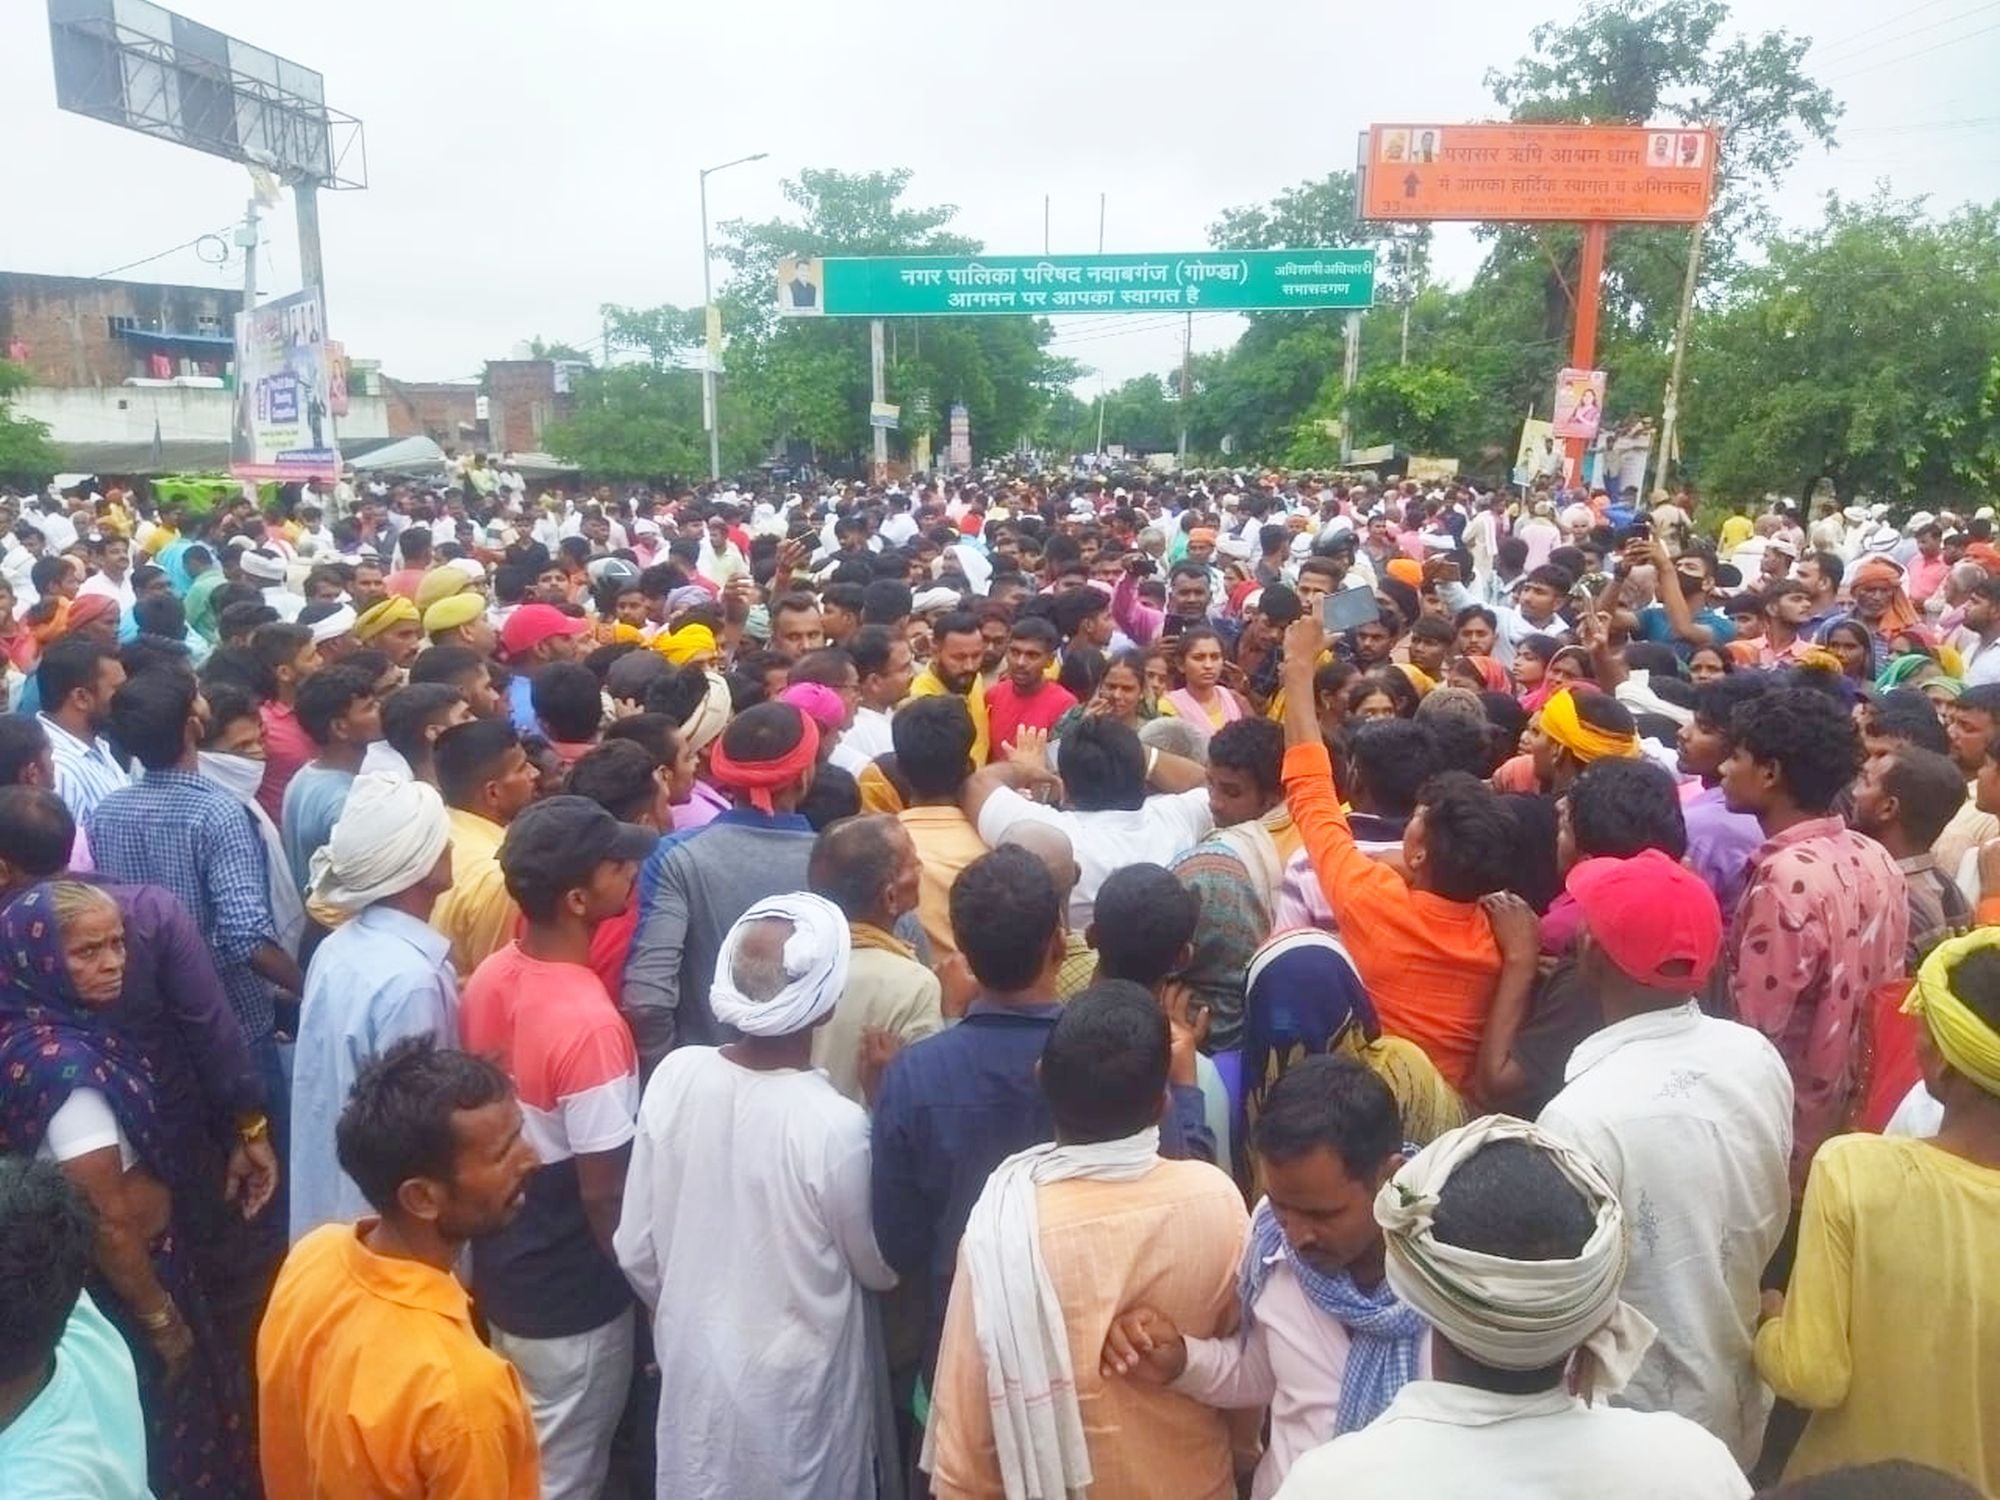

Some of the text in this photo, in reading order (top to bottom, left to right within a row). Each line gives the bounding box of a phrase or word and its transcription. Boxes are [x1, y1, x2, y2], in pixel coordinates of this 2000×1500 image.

[1444, 143, 1640, 164] परासर ऋषि आश्रम धाम
[1457, 178, 1505, 193] आपका
[1512, 174, 1556, 194] हार्दिक
[1564, 178, 1609, 194] स्वागत
[1632, 176, 1702, 196] अभिनन्दन
[901, 259, 1249, 286] नगर पालिका परिषद नवाबगंज (गोण्डा)
[947, 284, 1201, 308] आगमन पर आपका स्वागत है
